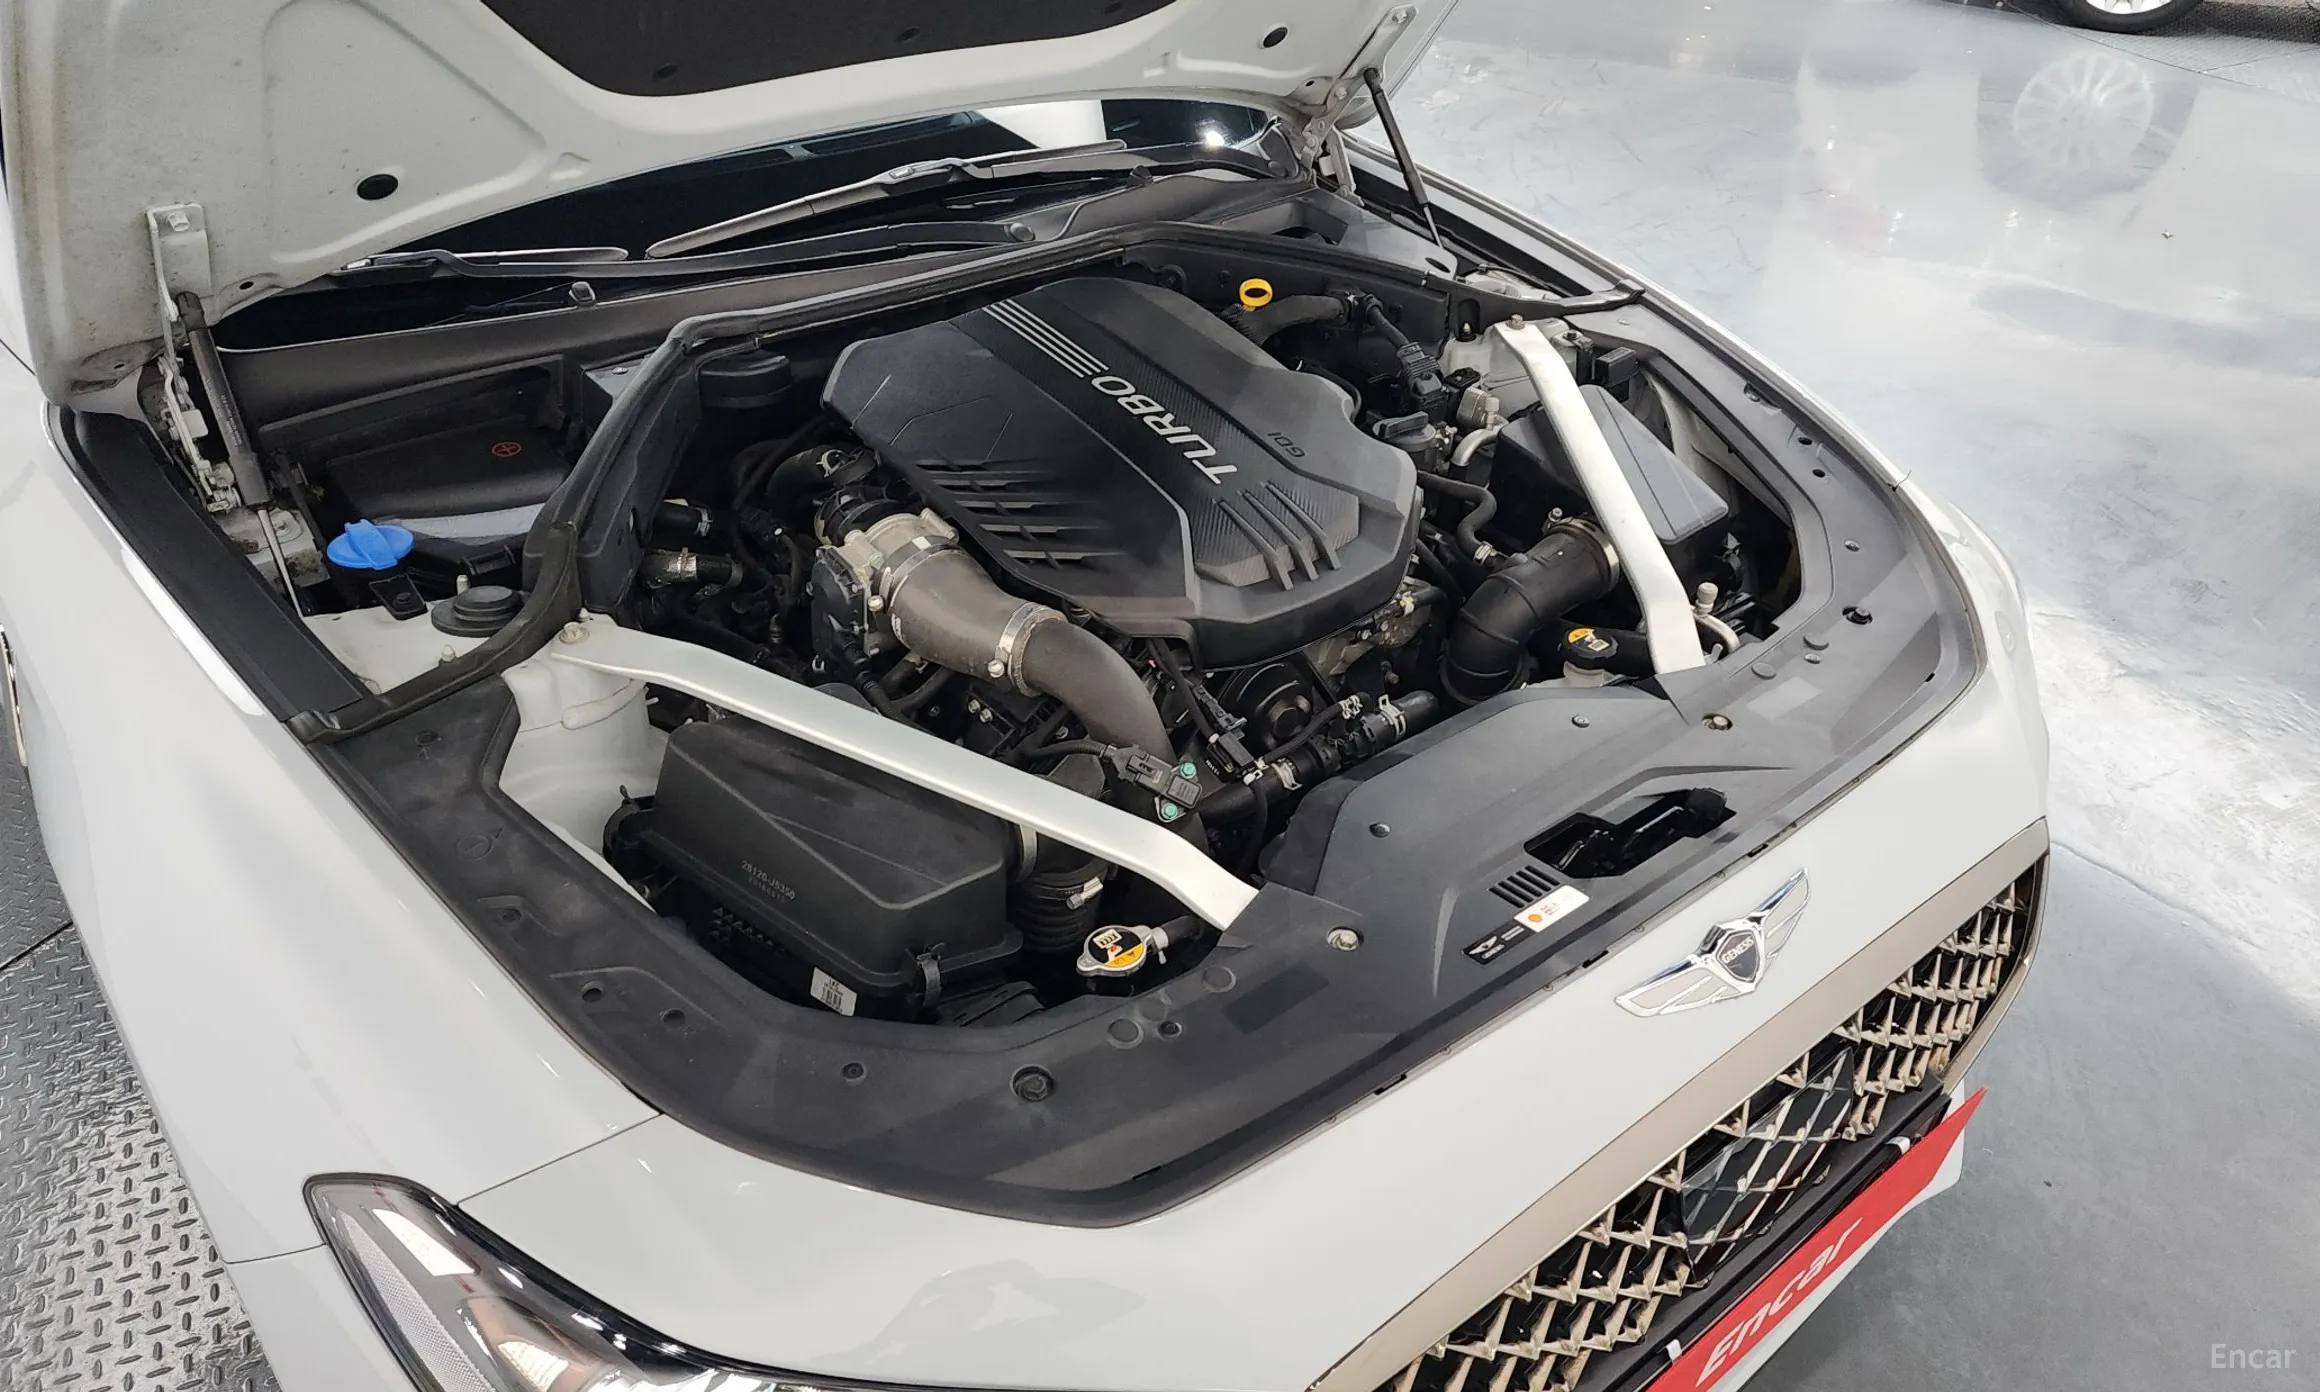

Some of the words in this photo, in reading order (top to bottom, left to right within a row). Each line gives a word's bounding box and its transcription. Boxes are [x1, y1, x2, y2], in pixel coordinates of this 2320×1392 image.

[1091, 376, 1237, 484] TURBO
[1267, 432, 1305, 457] GDI
[1721, 935, 1754, 964] GENESIS
[1696, 1217, 1862, 1387] Encar
